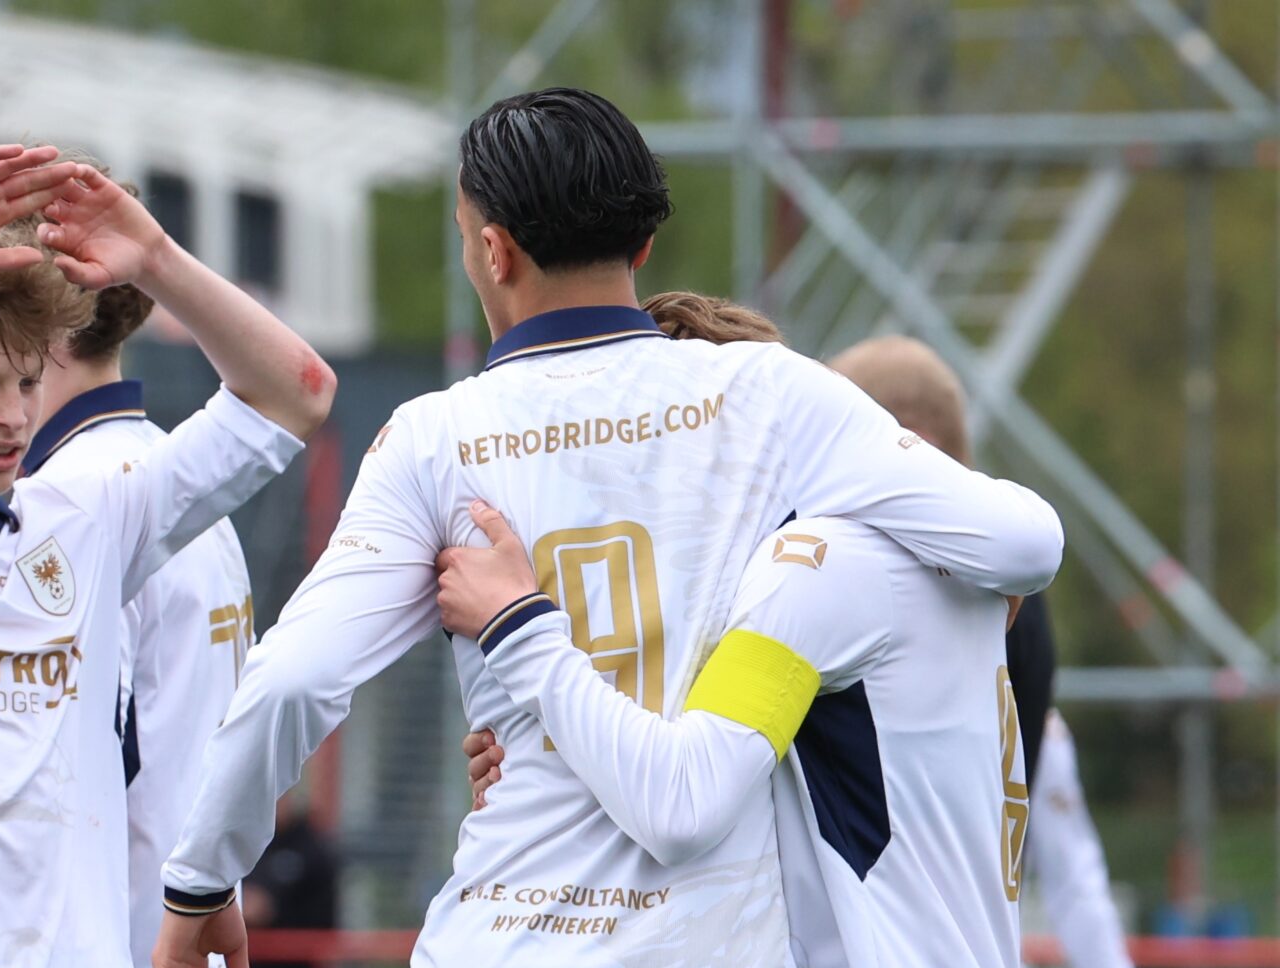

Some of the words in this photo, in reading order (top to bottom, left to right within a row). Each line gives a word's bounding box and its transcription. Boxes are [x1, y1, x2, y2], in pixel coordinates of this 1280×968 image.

[458, 393, 724, 466] RETROBRIDGE.COM
[532, 520, 664, 751] 9
[514, 884, 669, 911] CONSULTANCY
